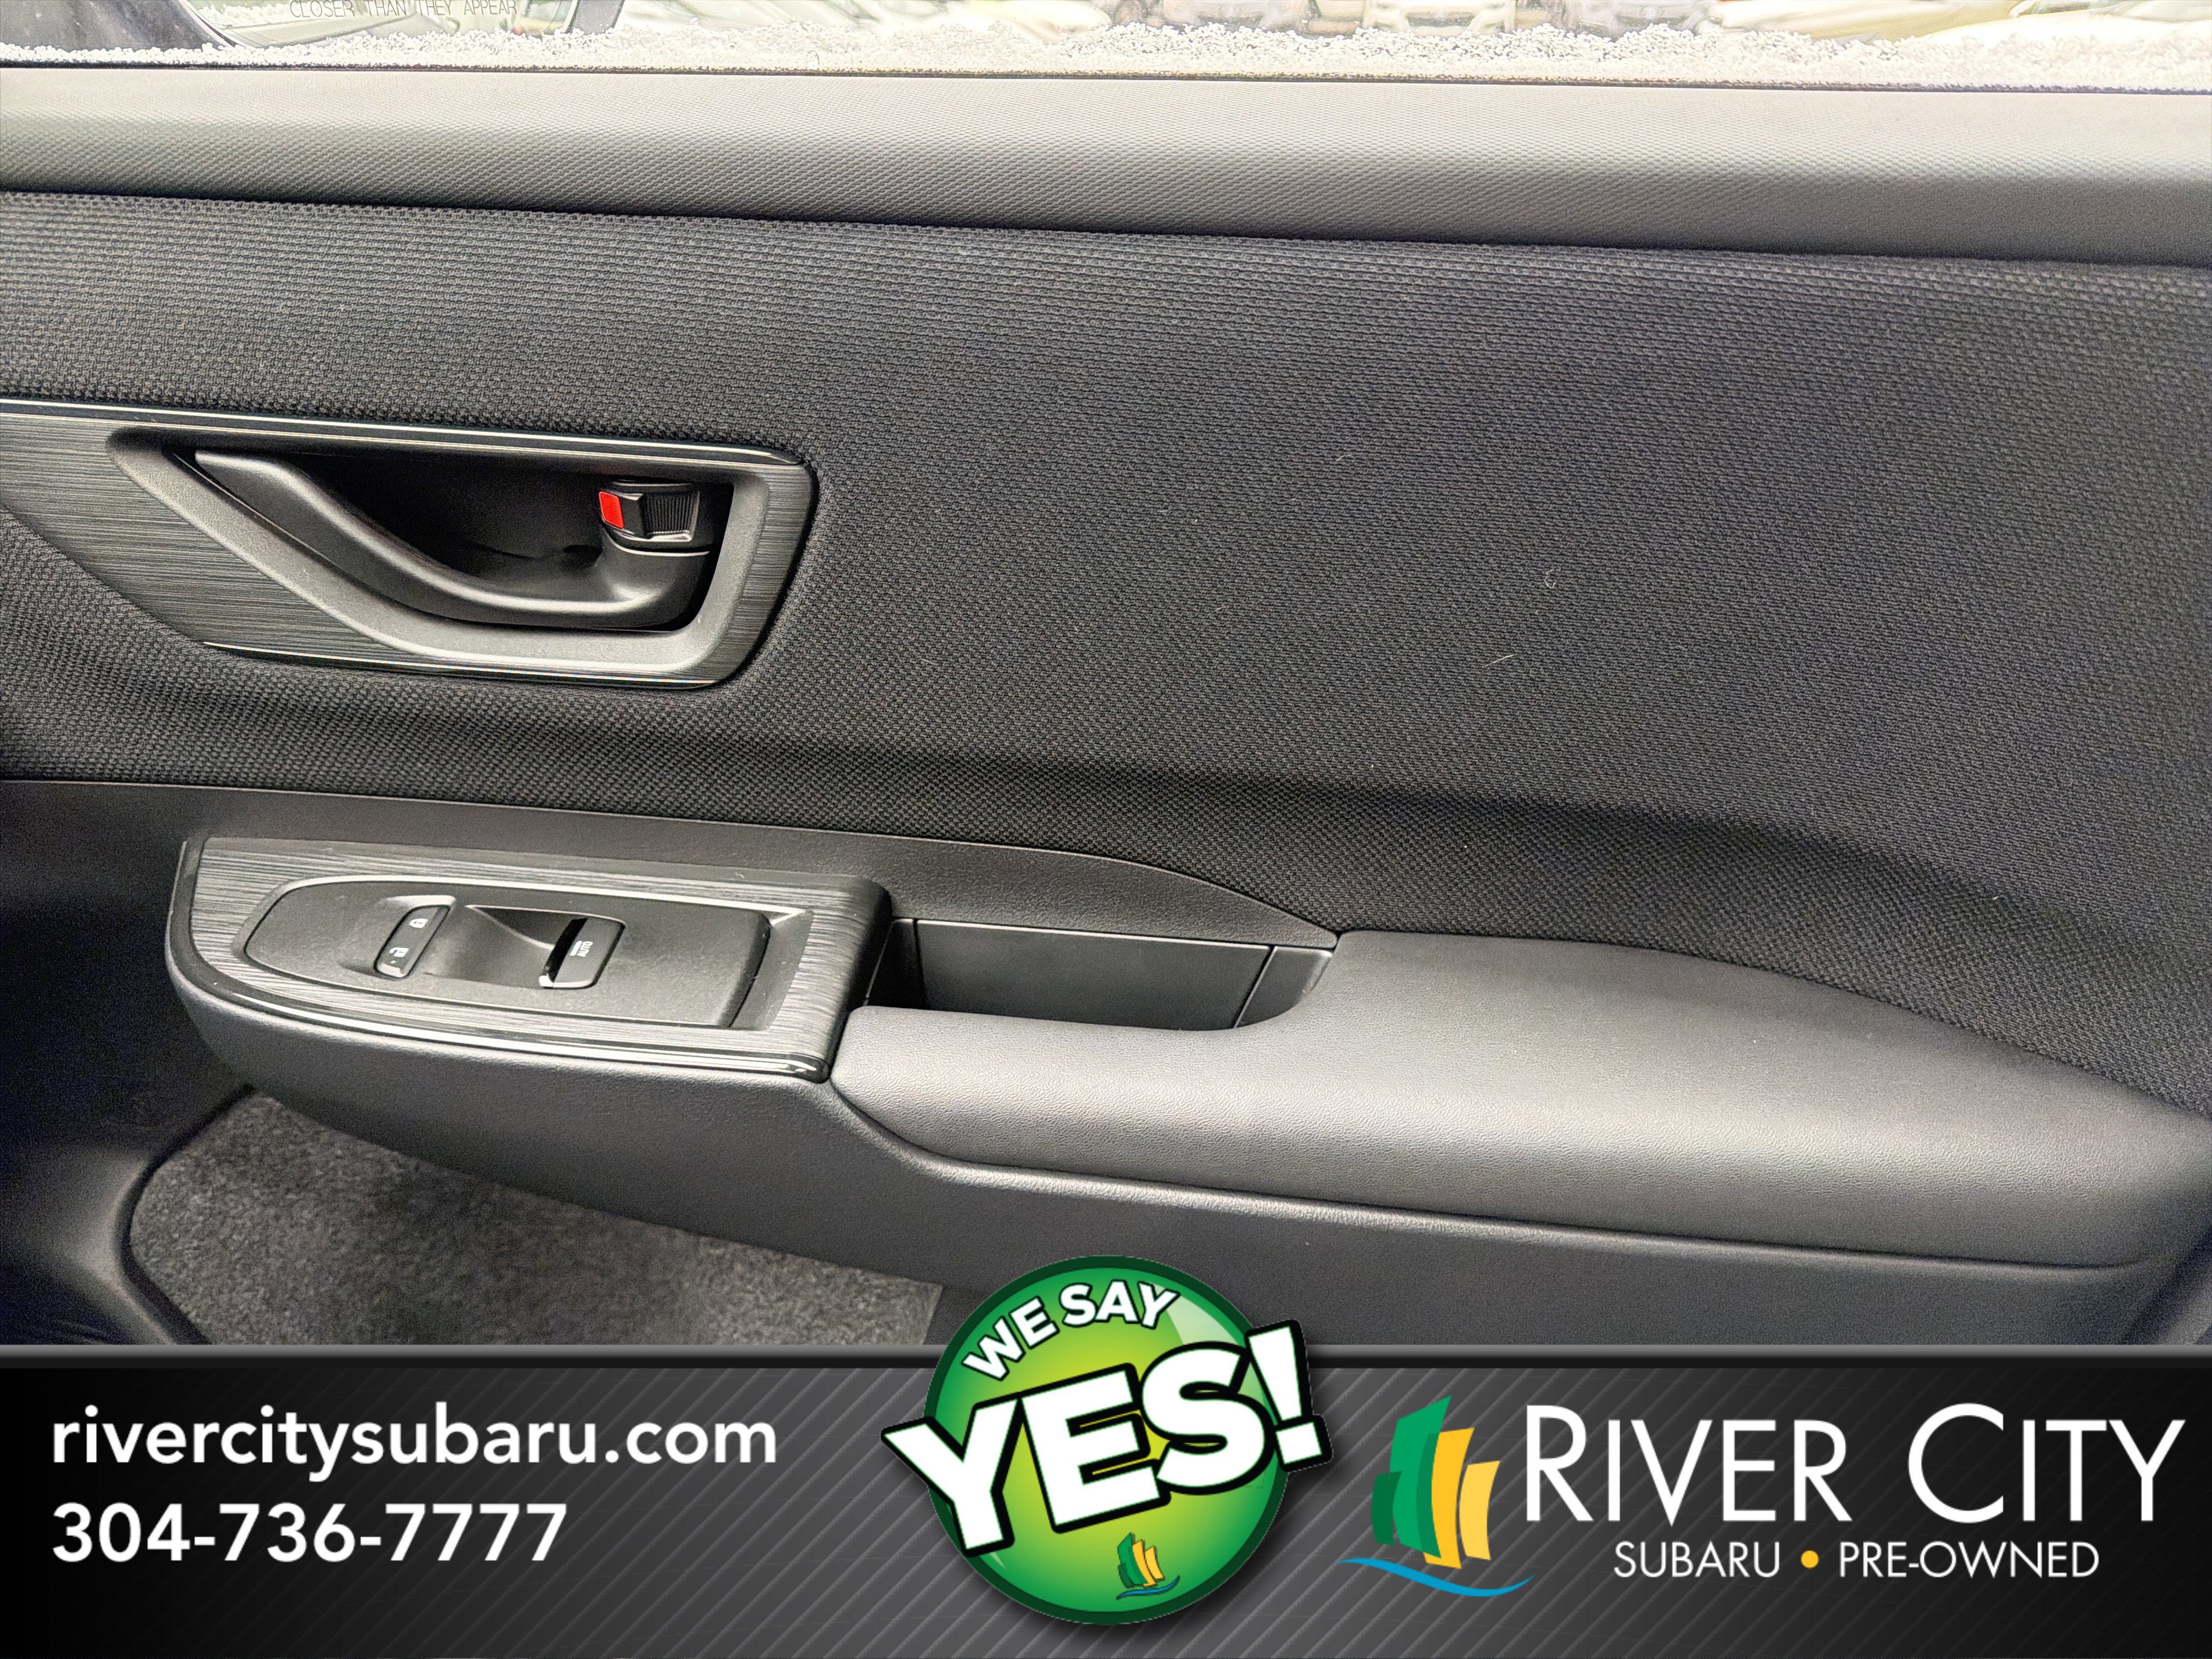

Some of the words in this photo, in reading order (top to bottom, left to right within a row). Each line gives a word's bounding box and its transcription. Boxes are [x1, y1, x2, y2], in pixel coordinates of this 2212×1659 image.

[290, 0, 355, 18] CLOSER
[365, 0, 407, 16] THAN
[416, 0, 452, 15] THEY
[464, 0, 517, 15] APPEAR
